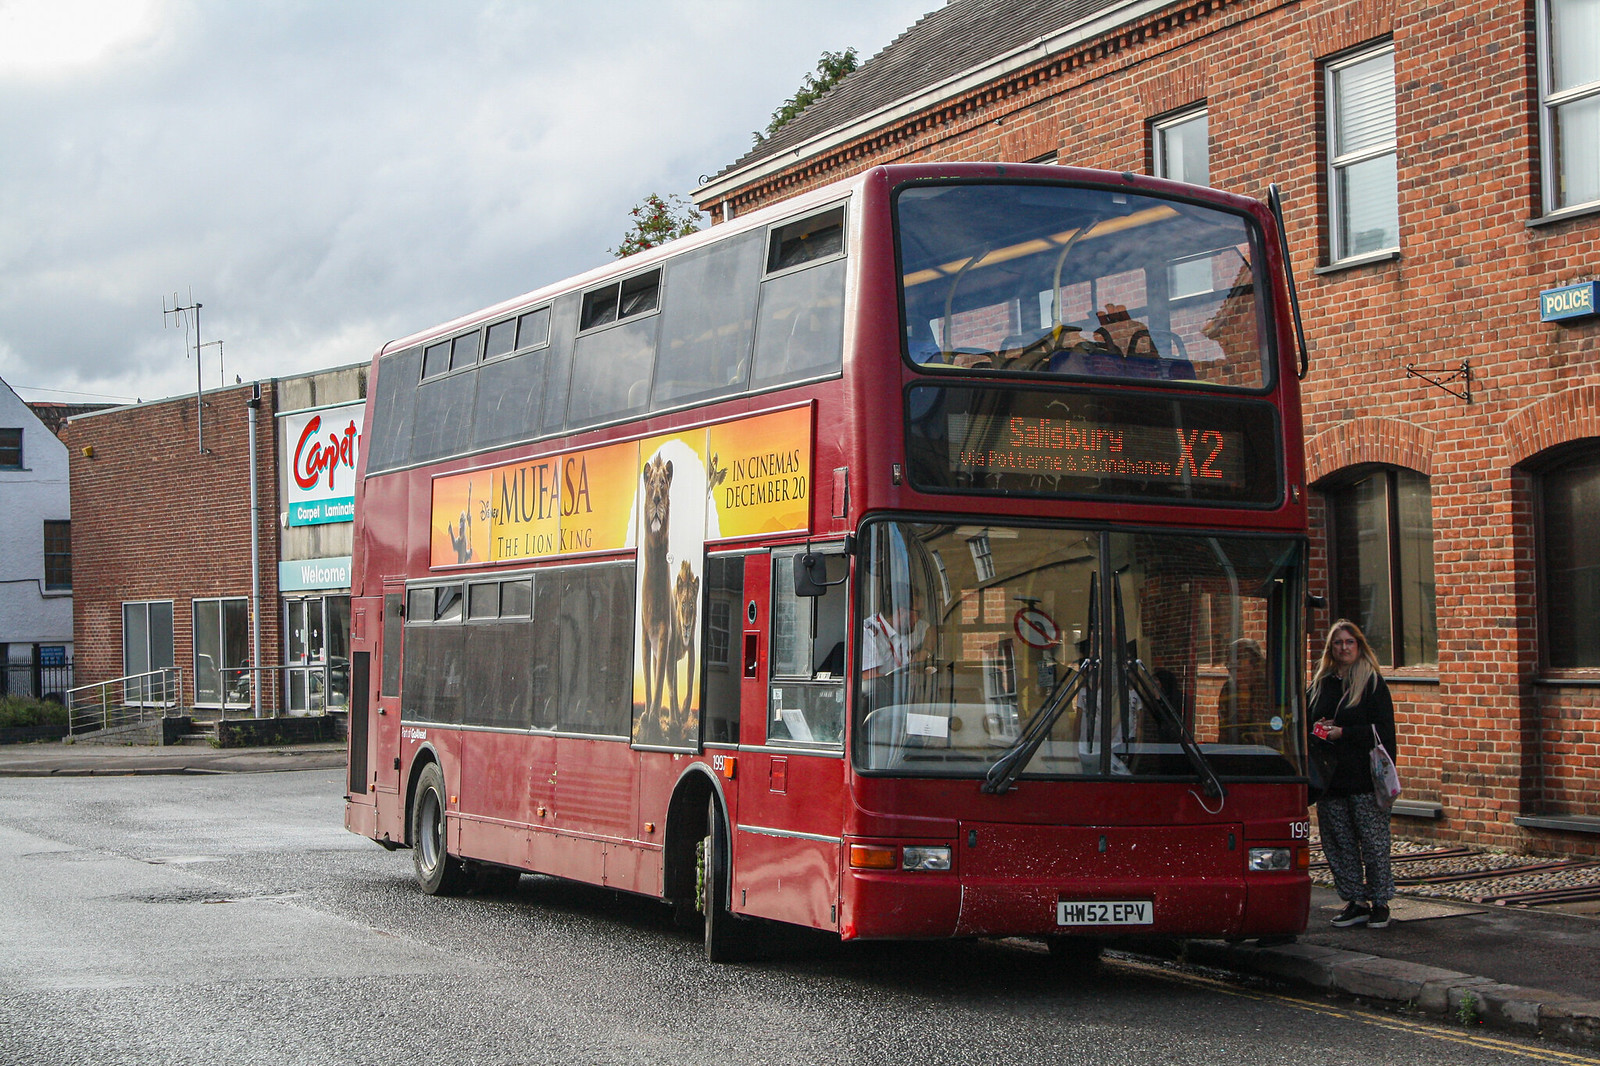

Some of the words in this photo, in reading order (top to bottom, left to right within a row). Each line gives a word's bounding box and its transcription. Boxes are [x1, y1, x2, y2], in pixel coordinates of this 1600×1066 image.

[1547, 289, 1589, 314] POLICE
[1009, 416, 1123, 452] Salisbury
[293, 415, 356, 490] Carpet
[732, 459, 746, 482] IN
[748, 449, 799, 479] CINEMAS
[988, 450, 1062, 470] Potterne
[1066, 455, 1077, 470] &
[1081, 455, 1171, 476] Stonehenge
[1174, 428, 1223, 478] X2
[498, 454, 593, 526] MUFASA
[726, 479, 790, 509] DECEMBER
[792, 475, 806, 500] 20
[297, 504, 320, 522] Carpet
[301, 566, 346, 584] Welcome
[1289, 821, 1310, 839] 199
[1064, 904, 1110, 923] HW52
[1113, 903, 1145, 922] EPV
